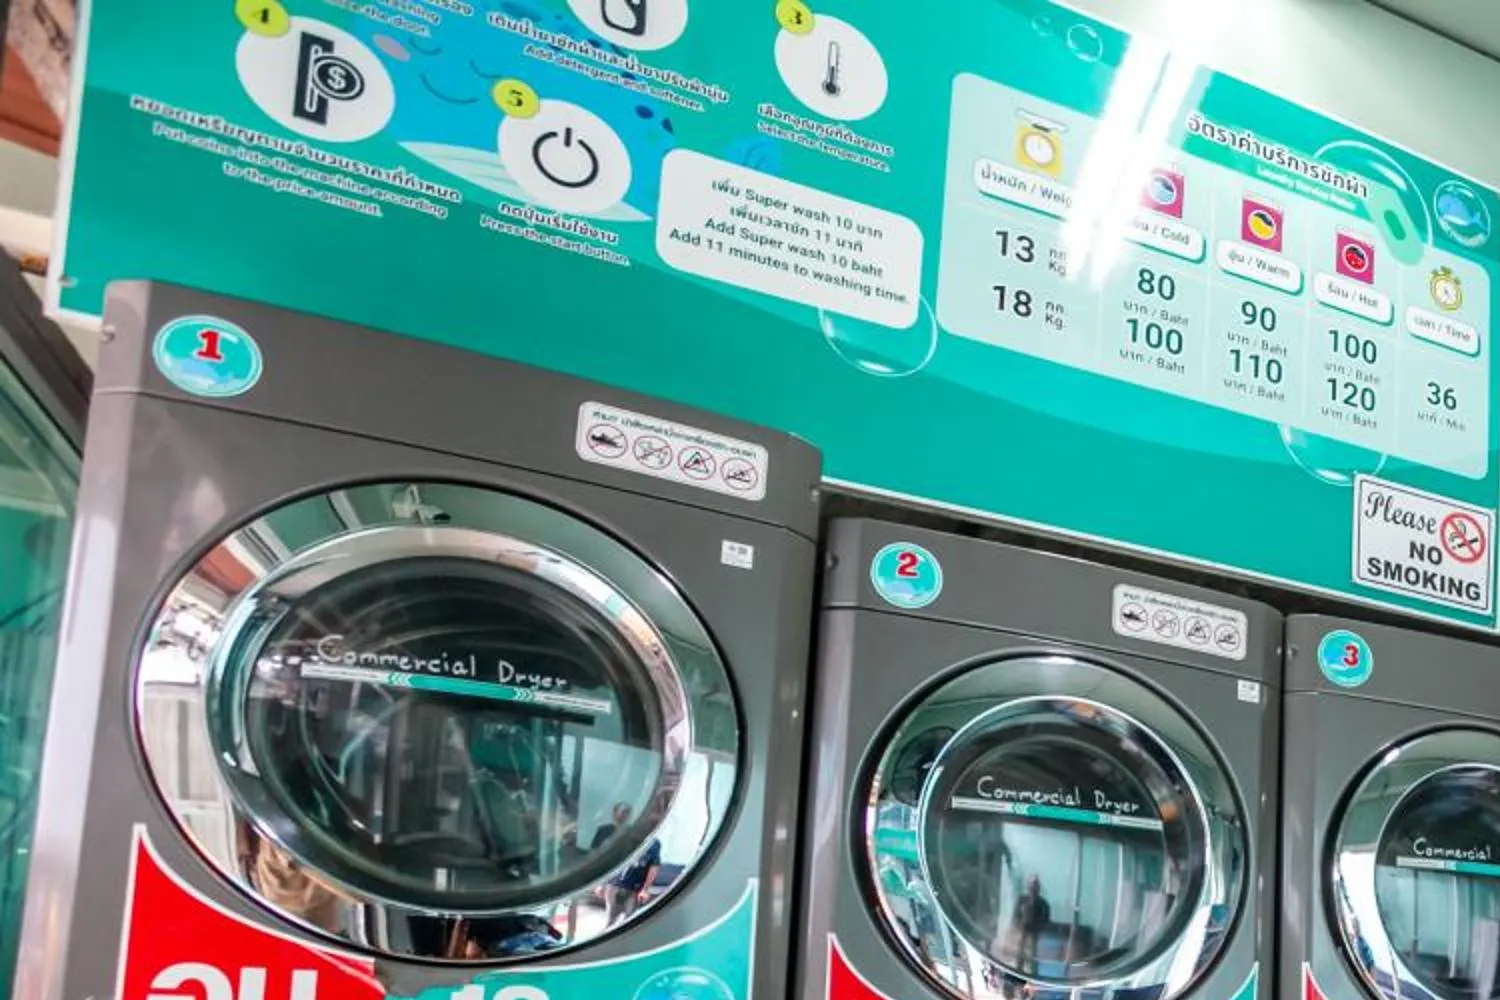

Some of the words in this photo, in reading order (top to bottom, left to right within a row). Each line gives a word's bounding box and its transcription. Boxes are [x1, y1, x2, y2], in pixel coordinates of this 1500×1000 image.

[255, 8, 270, 24] 4
[790, 11, 803, 26] 3
[508, 90, 524, 108] 5
[1186, 112, 1370, 200] อัตราค่าบริการซักผ้า
[711, 177, 740, 198] เพิ่ม
[746, 187, 788, 212] Super
[792, 201, 831, 224] wash
[835, 214, 853, 230] 10
[857, 222, 884, 240] บาท
[704, 217, 736, 237] Add
[740, 226, 785, 252] Super
[788, 239, 826, 262] wash
[830, 253, 847, 269] 10
[851, 259, 884, 279] baht
[815, 227, 832, 244] 11
[836, 233, 863, 253] นาที
[996, 230, 1035, 263] 13
[1160, 226, 1191, 246] Cold
[669, 228, 701, 247] Add
[706, 239, 724, 253] 11
[728, 245, 790, 272] minutes
[793, 265, 809, 278] to
[813, 269, 872, 298] washing
[1256, 258, 1291, 279] Warm
[1137, 268, 1176, 301] 80
[993, 285, 1032, 318] 18
[1241, 301, 1277, 333] 90
[196, 330, 223, 361] 1
[1126, 318, 1184, 355] 100
[1261, 339, 1288, 358] Baht
[1328, 329, 1378, 365] 100
[1156, 357, 1186, 375] Baht
[1229, 349, 1284, 385] 110
[1258, 385, 1286, 402] Baht
[1327, 378, 1376, 412] 120
[1426, 382, 1458, 411] 36
[1364, 491, 1437, 535] Please
[896, 551, 918, 578] 2
[1409, 541, 1444, 566] NO
[1367, 556, 1482, 602] SMOKING
[317, 634, 477, 676] Commercial
[497, 660, 568, 690] Dryer
[1344, 645, 1360, 667] 3
[976, 775, 1081, 806] Commercial
[1093, 789, 1139, 815] Dryer
[1413, 837, 1491, 861] Commercial
